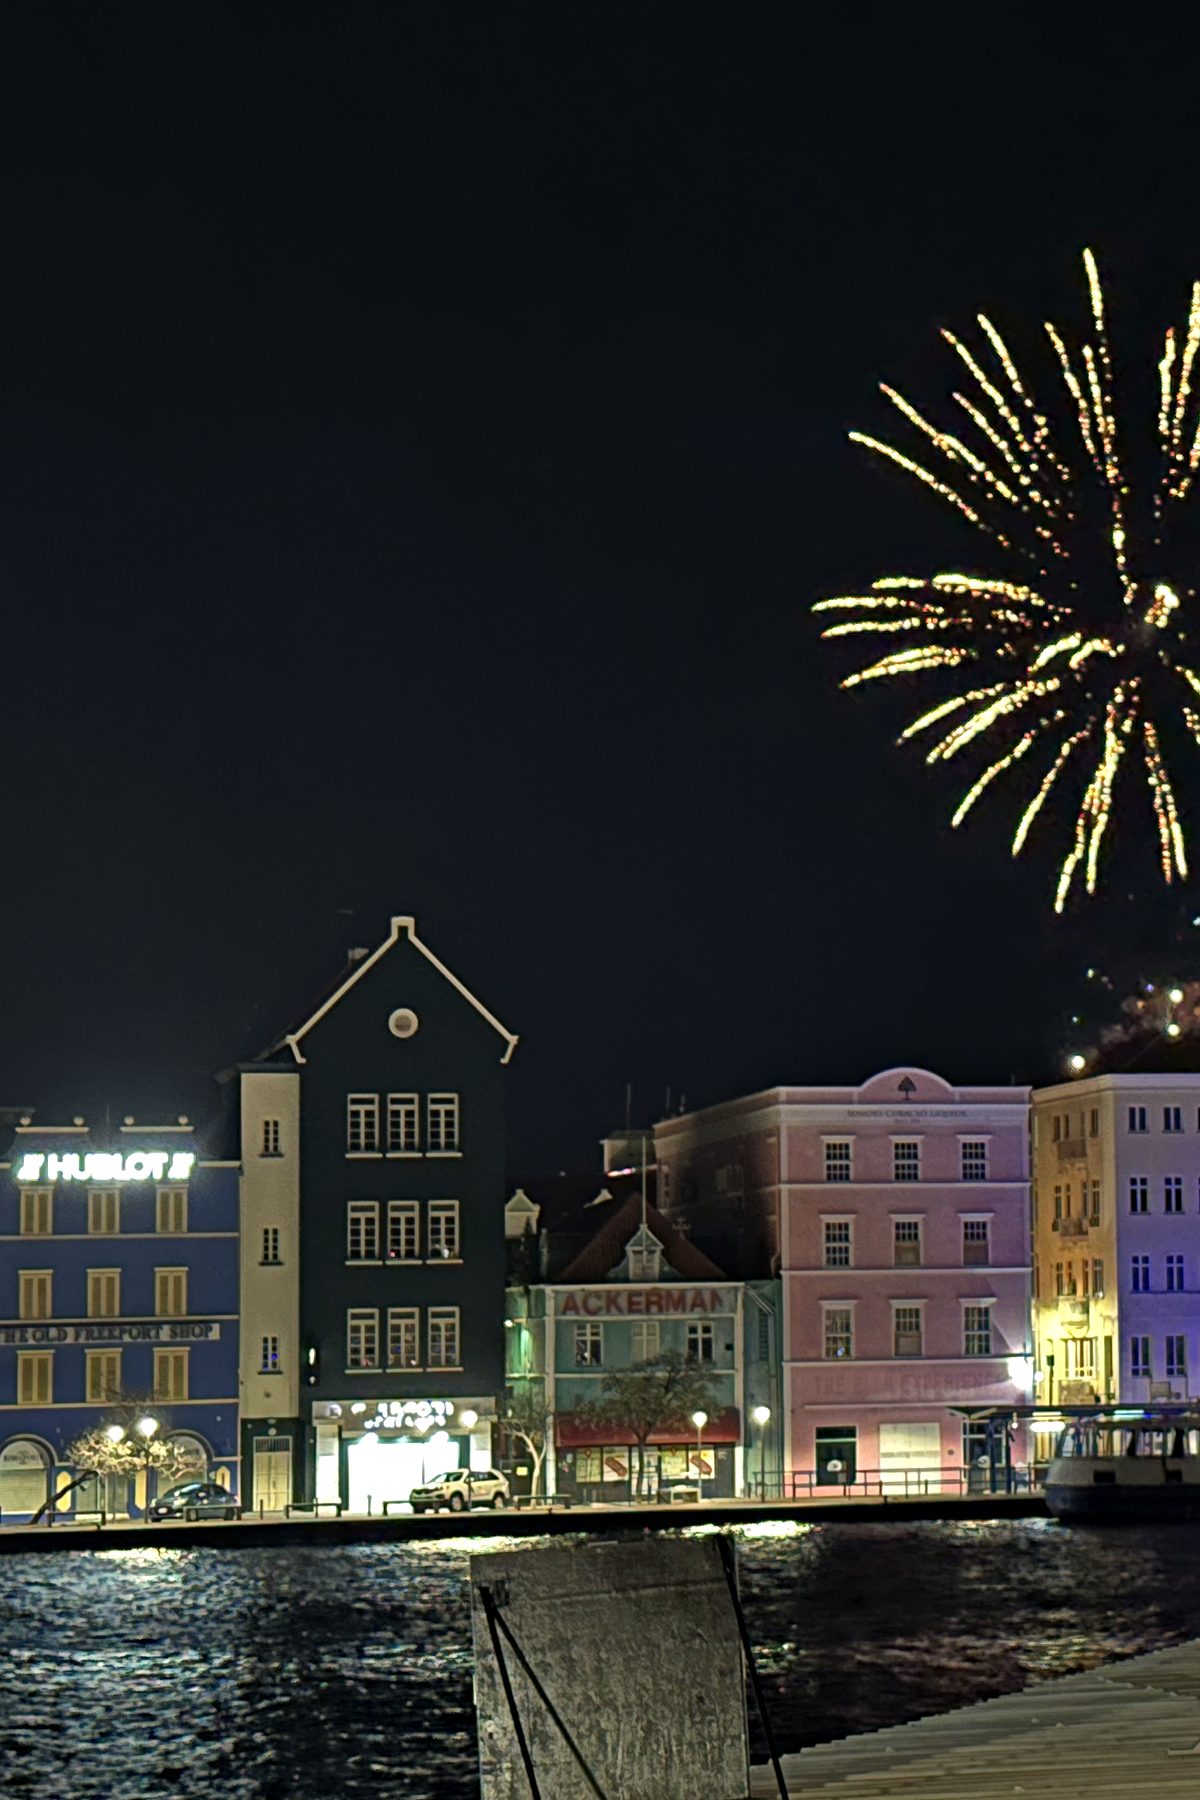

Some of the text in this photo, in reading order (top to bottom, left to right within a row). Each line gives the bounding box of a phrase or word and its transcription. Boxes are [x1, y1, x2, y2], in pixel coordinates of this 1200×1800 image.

[47, 1152, 169, 1181] HUBLOT
[32, 1327, 68, 1342] OLD
[74, 1325, 163, 1342] FREEPORT
[169, 1324, 214, 1340] SHOP
